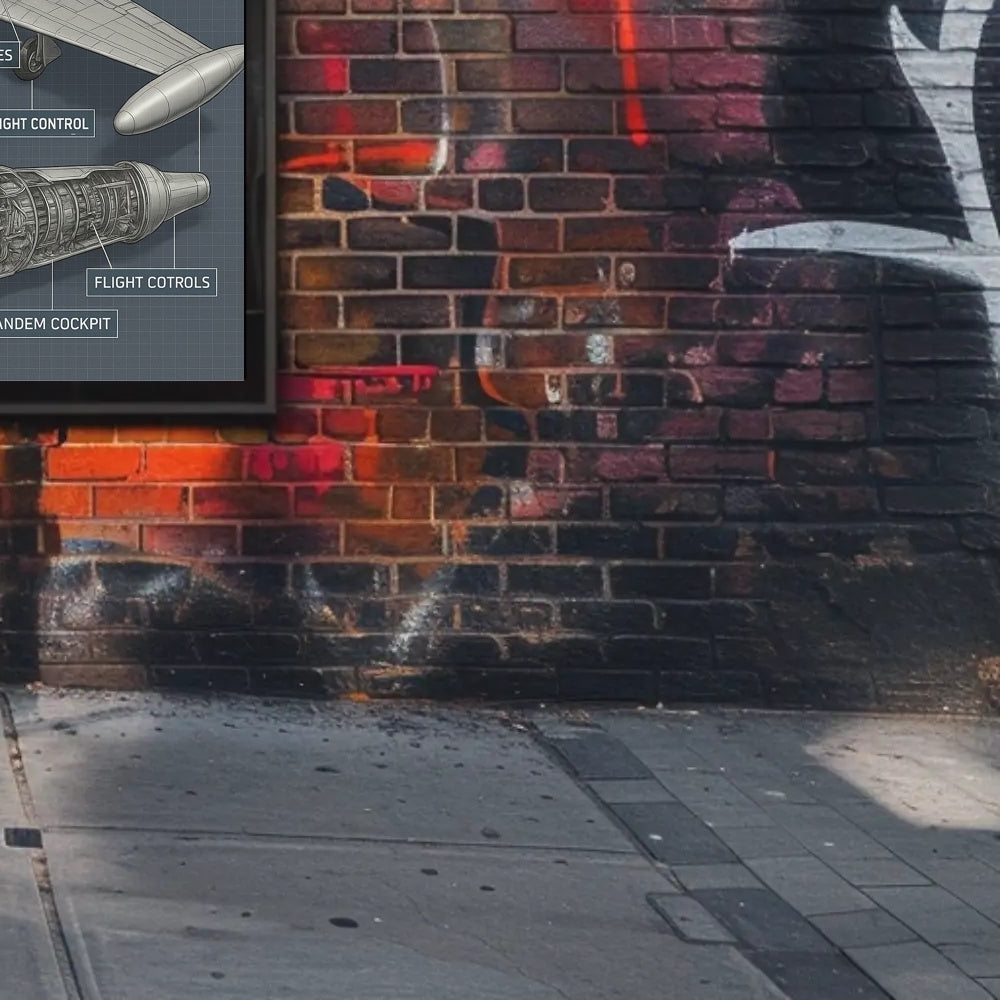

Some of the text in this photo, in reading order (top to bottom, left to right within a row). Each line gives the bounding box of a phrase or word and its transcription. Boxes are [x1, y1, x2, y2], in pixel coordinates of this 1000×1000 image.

[30, 117, 89, 130] CONTROL
[94, 276, 210, 289] FLIGHT COTROLS
[50, 317, 112, 331] COCKPIT
